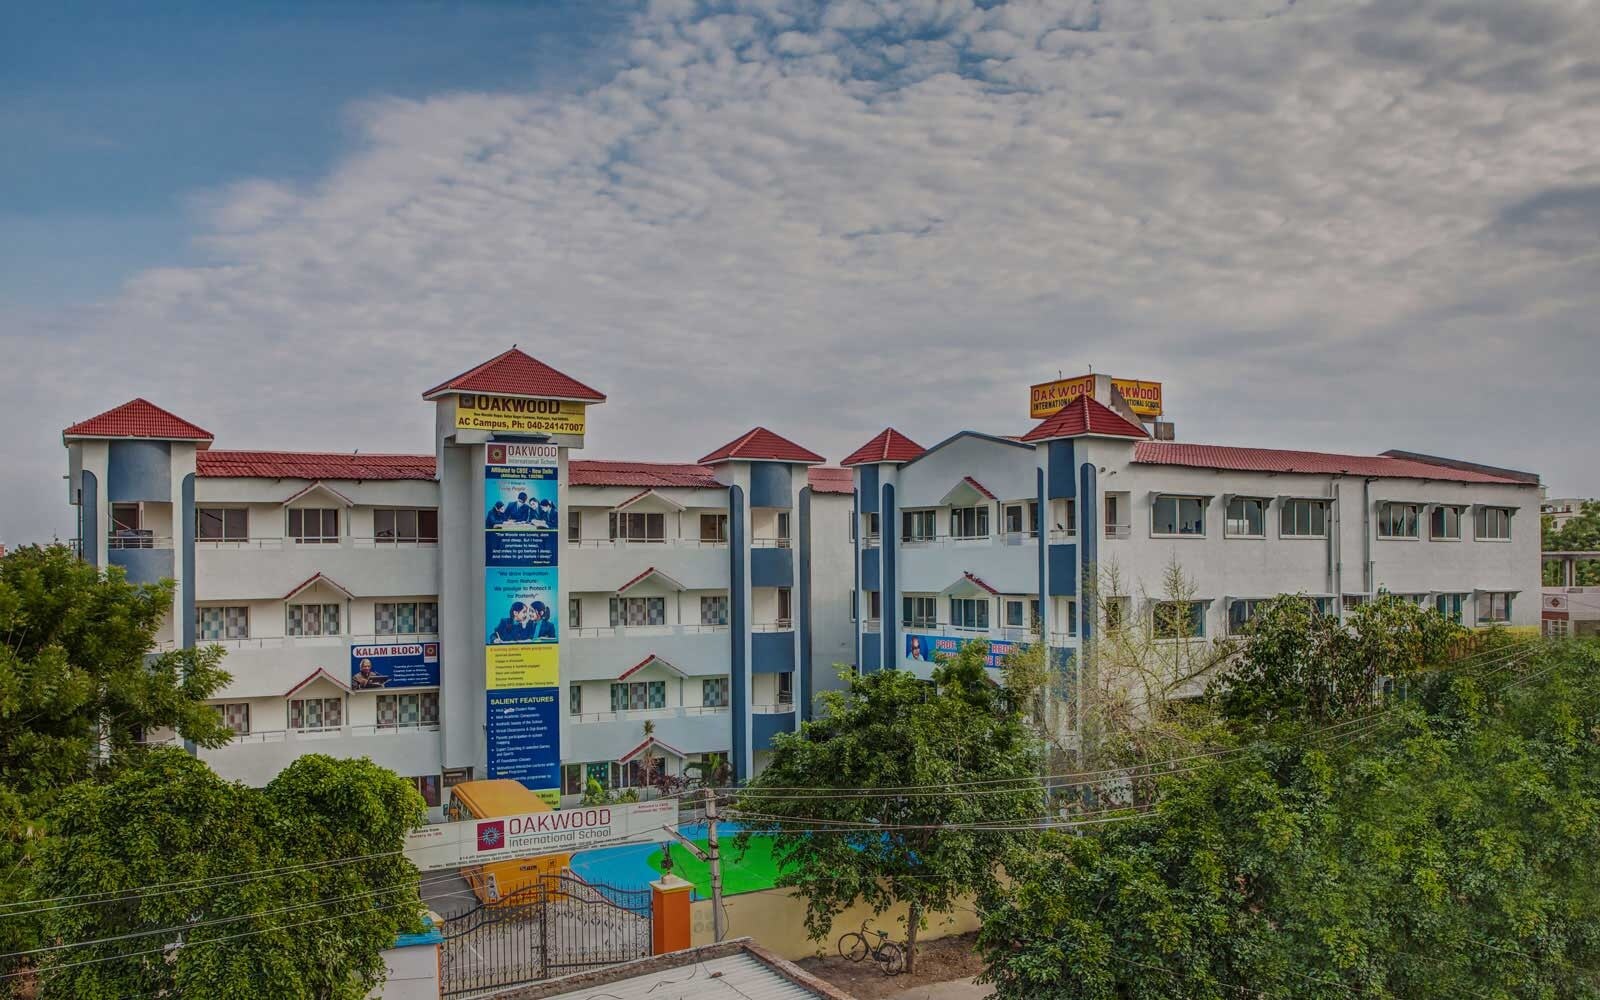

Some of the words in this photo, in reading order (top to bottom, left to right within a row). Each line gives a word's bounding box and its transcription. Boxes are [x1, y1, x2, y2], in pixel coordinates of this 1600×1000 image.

[1034, 380, 1092, 402] OAKWOOD
[478, 395, 560, 414] OAKWOOD
[473, 418, 509, 429] Campus,
[527, 421, 583, 431] 040-24147007
[508, 445, 556, 457] OAKWOOD
[356, 648, 388, 656] KALAM
[509, 809, 611, 835] OAKWOOD
[509, 830, 575, 848] International
[578, 826, 611, 840] School
